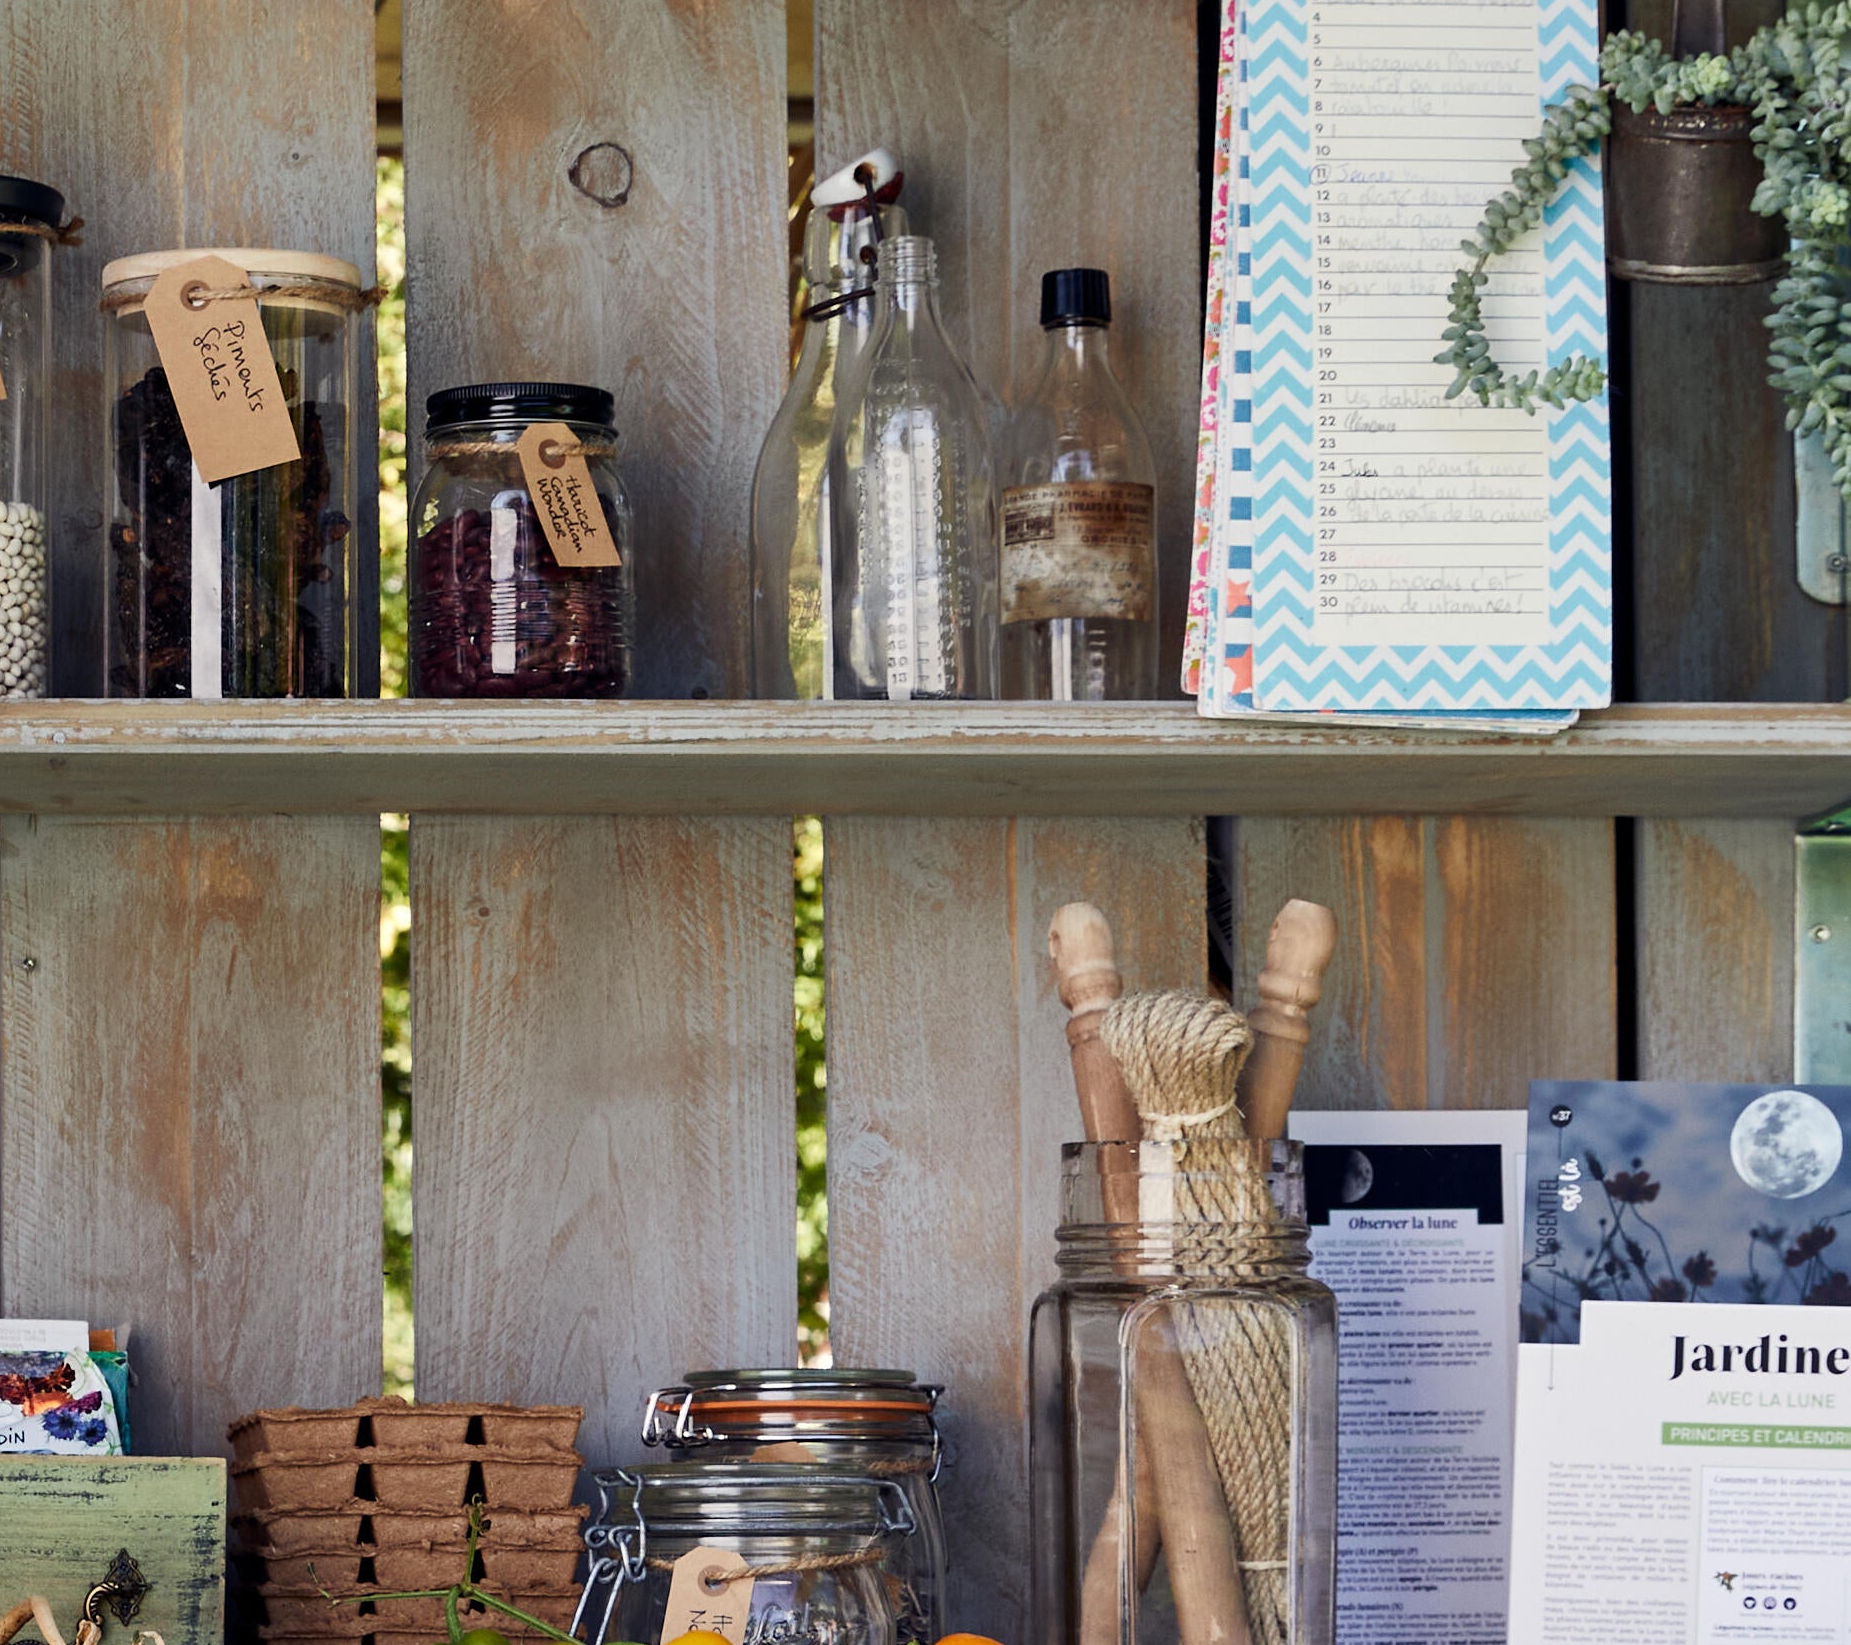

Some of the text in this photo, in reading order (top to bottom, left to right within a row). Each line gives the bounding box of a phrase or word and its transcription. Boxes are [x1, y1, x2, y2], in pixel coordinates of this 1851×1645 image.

[1312, 12, 1321, 22] 4
[1313, 34, 1321, 44] 5
[1313, 56, 1322, 67] 6
[1314, 78, 1322, 89] 7
[1314, 101, 1323, 111] 8
[1315, 123, 1324, 133] 9
[1315, 145, 1331, 156] 10
[1316, 168, 1327, 178] 11
[1317, 190, 1330, 201] 12
[1317, 212, 1331, 223] 13
[1317, 235, 1331, 246] 14
[1317, 258, 1331, 268] 15
[1317, 280, 1332, 291] 16
[1318, 303, 1331, 313] 17
[1318, 325, 1332, 336] 18
[1318, 348, 1332, 358] 19
[193, 327, 230, 401] Séchés
[223, 320, 264, 412] Piments
[1319, 371, 1337, 381] 20
[1319, 393, 1332, 404] 21
[1319, 416, 1336, 426] 22
[1319, 439, 1336, 449] 23
[1319, 461, 1336, 471] 24
[1319, 484, 1336, 494] 25
[566, 475, 597, 537] Haricot
[1320, 506, 1337, 517] 26
[550, 476, 582, 553] Canadian
[1320, 529, 1337, 539] 27
[1320, 551, 1337, 562] 28
[1320, 574, 1337, 584] 29
[1320, 596, 1338, 607] 30
[1348, 1216, 1458, 1230] Observer la lune
[1707, 1391, 1836, 1409] AVEC LA LUNE
[1670, 1427, 1750, 1442] PRINCIPES
[1753, 1429, 1771, 1443] ET
